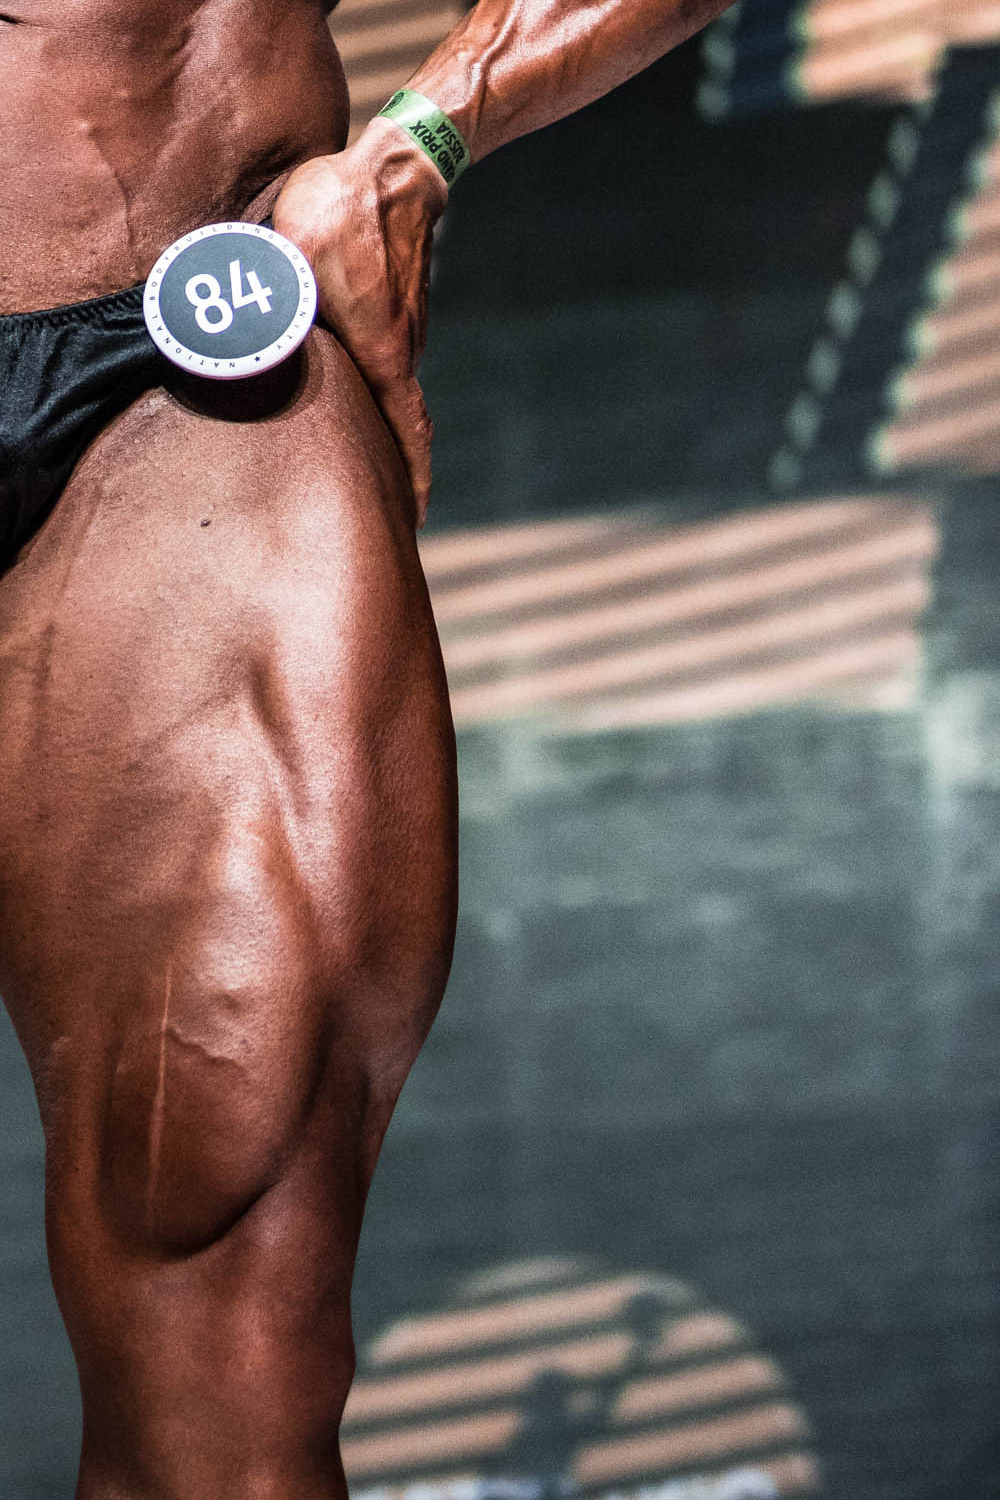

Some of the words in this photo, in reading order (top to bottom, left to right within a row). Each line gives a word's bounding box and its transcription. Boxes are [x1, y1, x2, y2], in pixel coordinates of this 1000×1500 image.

[408, 120, 442, 154] PRIX
[435, 121, 465, 164] RUSSIA
[149, 224, 275, 301] BODYBUILDING
[185, 259, 273, 334] 84
[276, 243, 310, 351] COMMUNITY
[151, 314, 236, 369] NATIONAL
